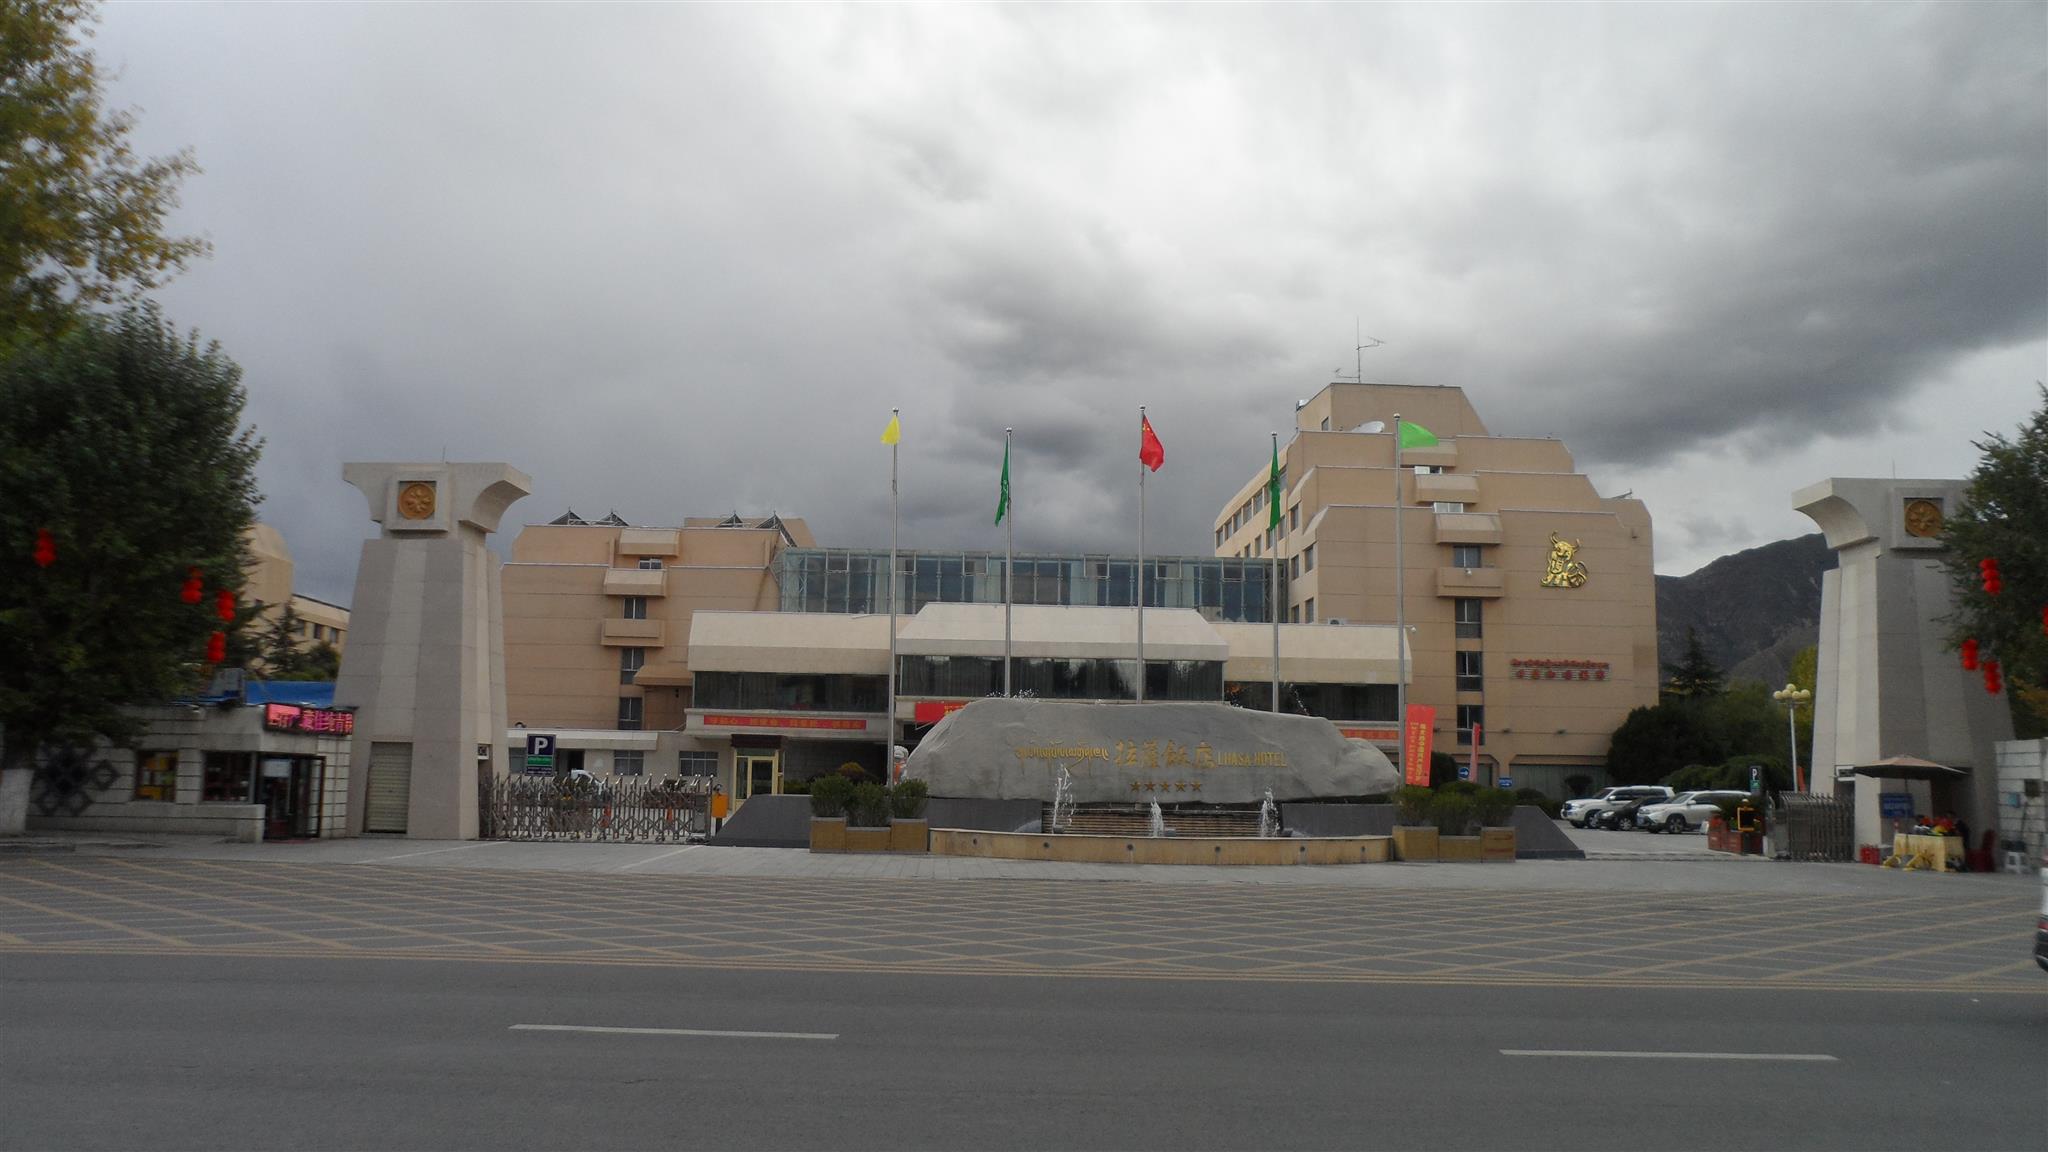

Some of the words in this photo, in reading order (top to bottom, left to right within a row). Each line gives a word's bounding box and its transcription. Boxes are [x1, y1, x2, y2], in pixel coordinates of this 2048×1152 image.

[534, 737, 549, 755] P
[1254, 751, 1288, 767] HOTEL
[1752, 768, 1758, 780] P
